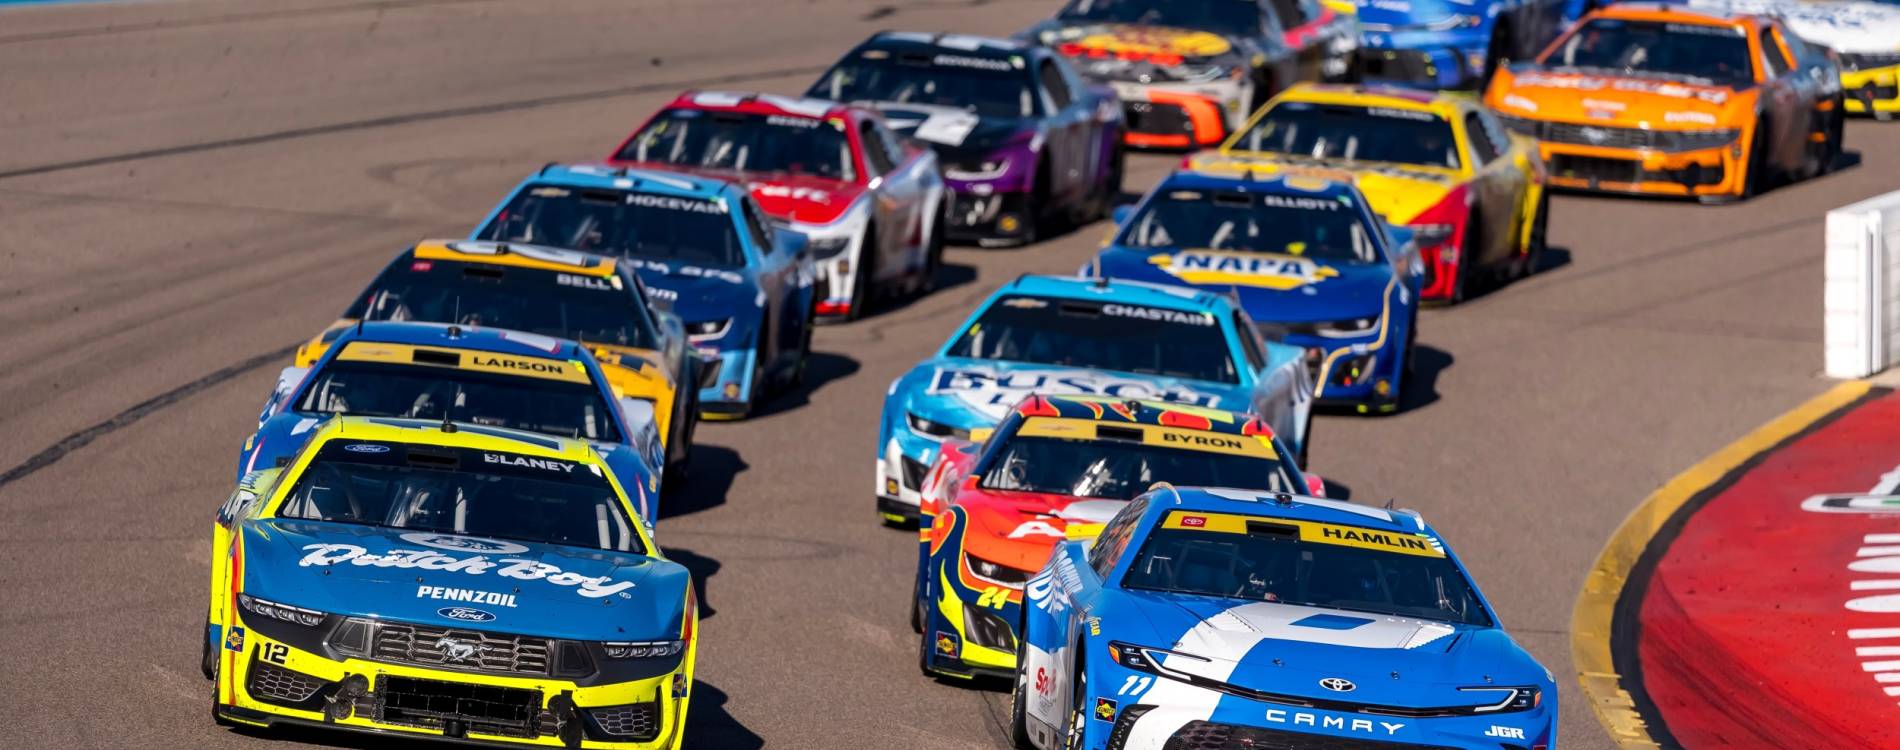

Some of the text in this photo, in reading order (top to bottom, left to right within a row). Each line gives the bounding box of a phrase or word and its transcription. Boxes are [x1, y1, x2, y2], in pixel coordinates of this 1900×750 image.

[1264, 196, 1339, 211] ELLIOTT
[1183, 254, 1303, 275] NAPA
[556, 273, 611, 290] BELL
[1102, 303, 1215, 326] CHASTAIN
[473, 356, 563, 374] LARSON
[1163, 433, 1243, 449] BYRON
[484, 453, 575, 473] BLANEY
[1322, 527, 1426, 550] HAMLIN
[299, 543, 635, 598] Dutch Boy
[417, 585, 518, 608] PENNZOIL
[976, 586, 1012, 610] 24
[442, 607, 490, 621] Ford
[264, 642, 289, 664] 12
[1117, 675, 1152, 696] 11
[1266, 709, 1406, 735] CAMRY
[1484, 725, 1526, 740] JGR
